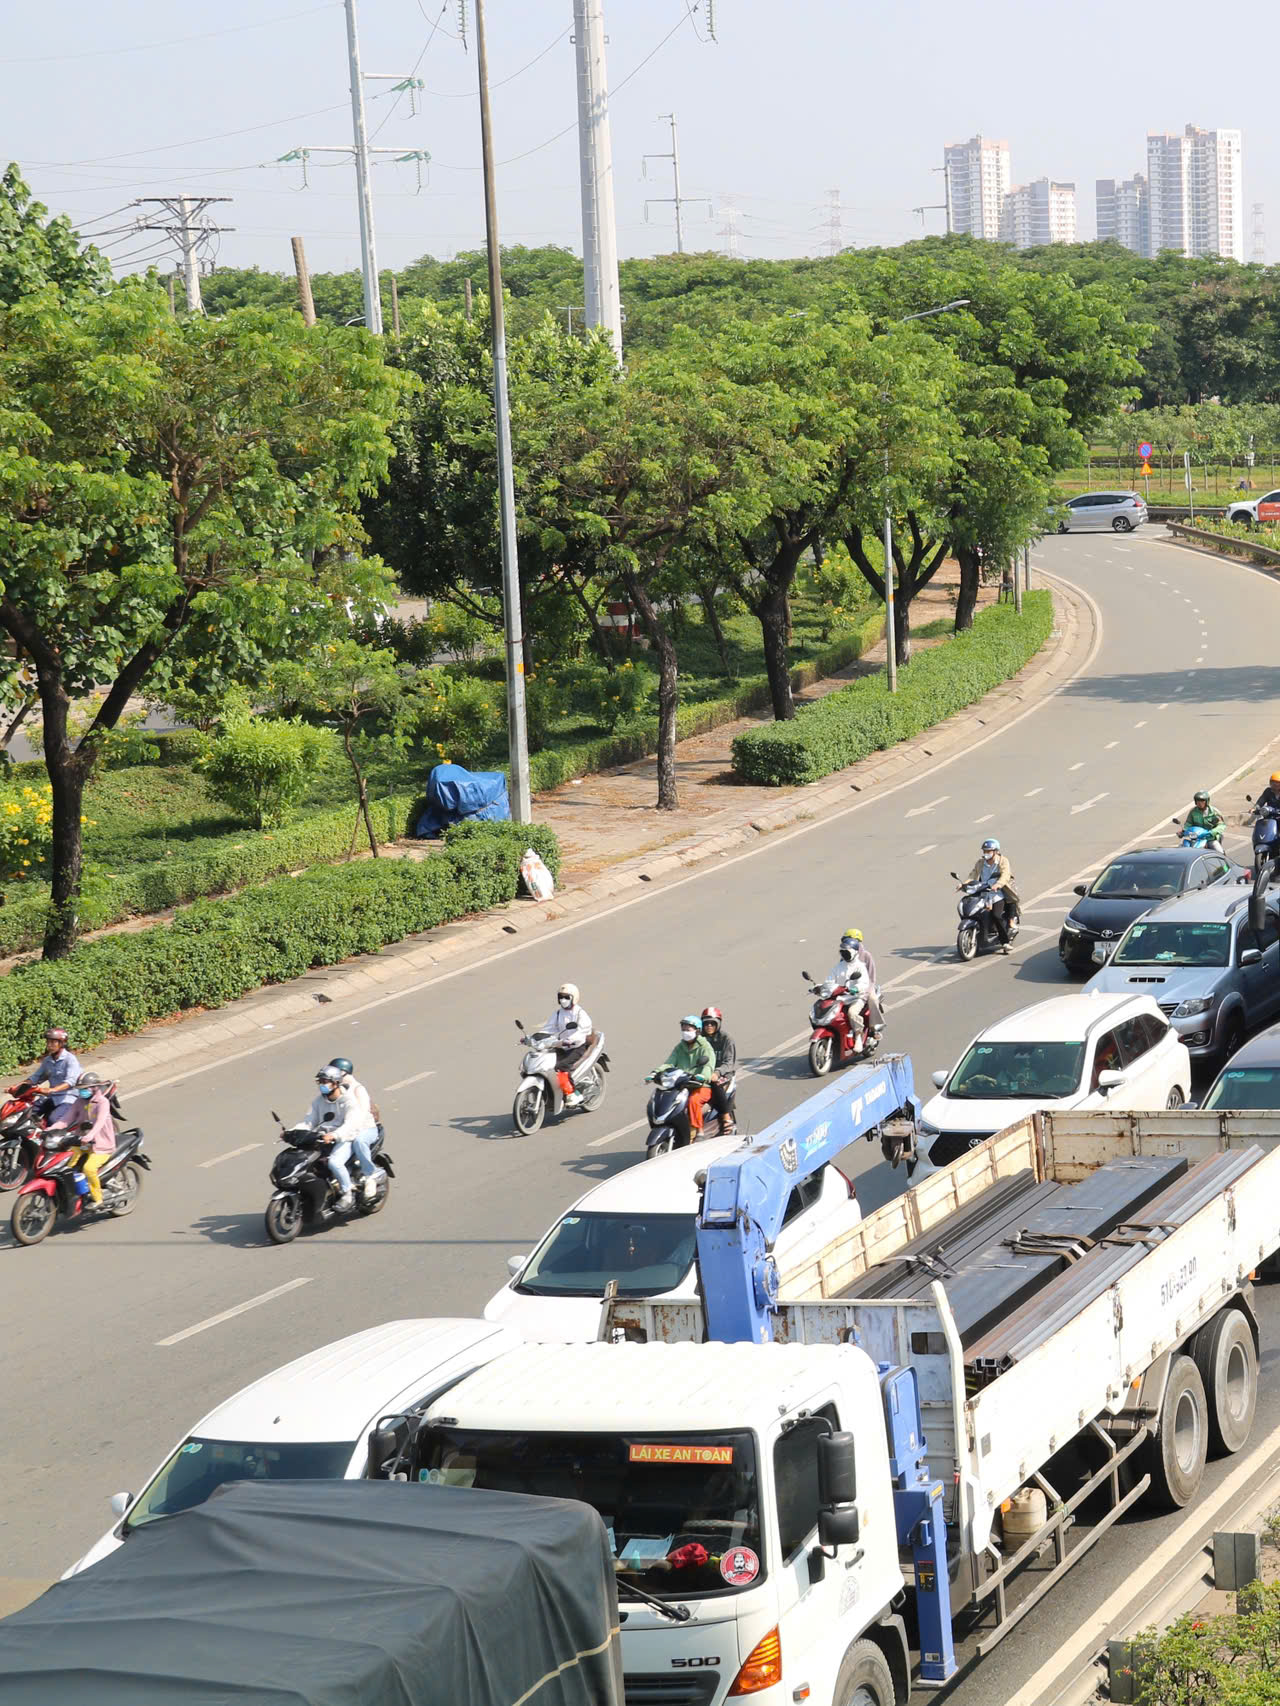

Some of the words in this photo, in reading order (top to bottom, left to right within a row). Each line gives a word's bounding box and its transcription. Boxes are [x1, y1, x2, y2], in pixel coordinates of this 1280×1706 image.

[631, 1445, 652, 1460] LÁI
[655, 1448, 671, 1460] XE
[673, 1448, 692, 1461] AN
[695, 1447, 731, 1462] TOÀN
[671, 1656, 721, 1668] 500
